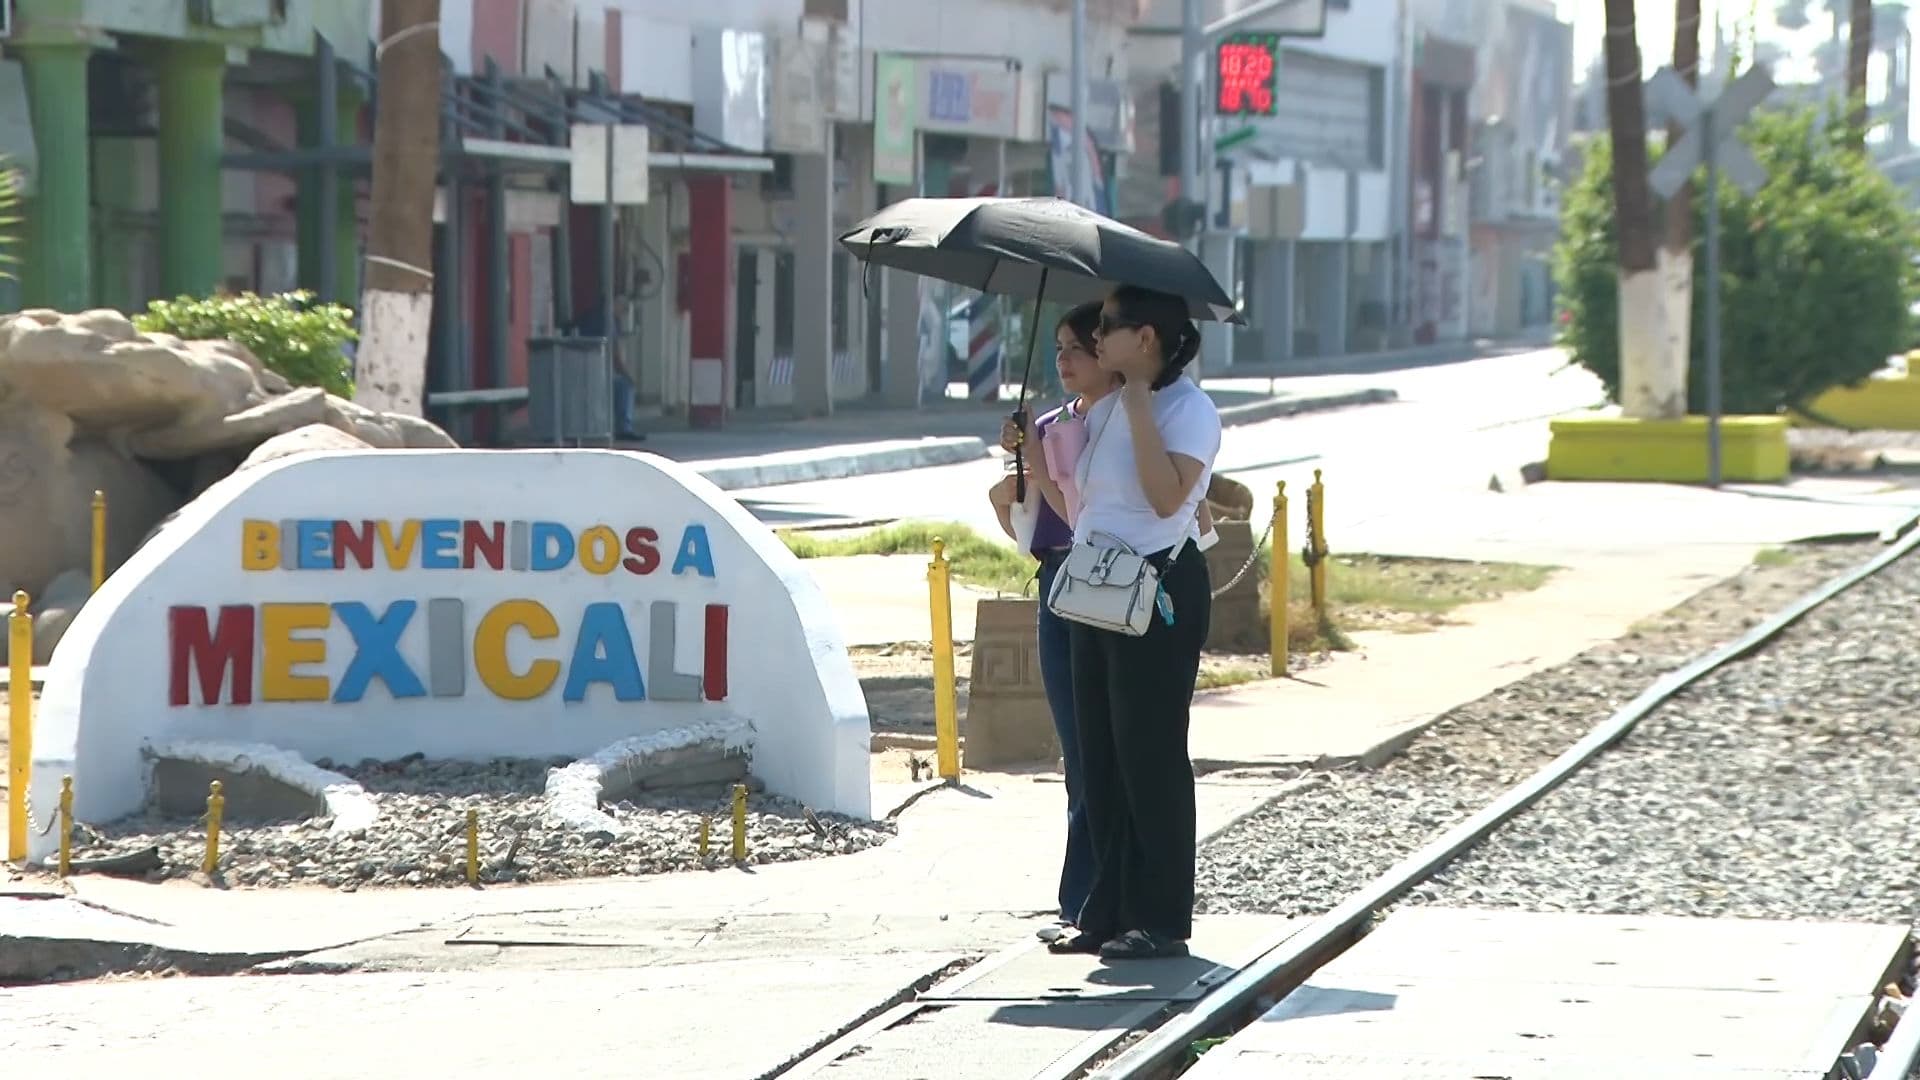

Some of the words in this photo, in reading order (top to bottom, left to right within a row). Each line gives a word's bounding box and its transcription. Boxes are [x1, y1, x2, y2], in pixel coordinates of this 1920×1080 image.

[242, 519, 661, 576] BIENVENIDOS
[671, 524, 717, 578] A
[168, 598, 729, 706] MEXICALI
